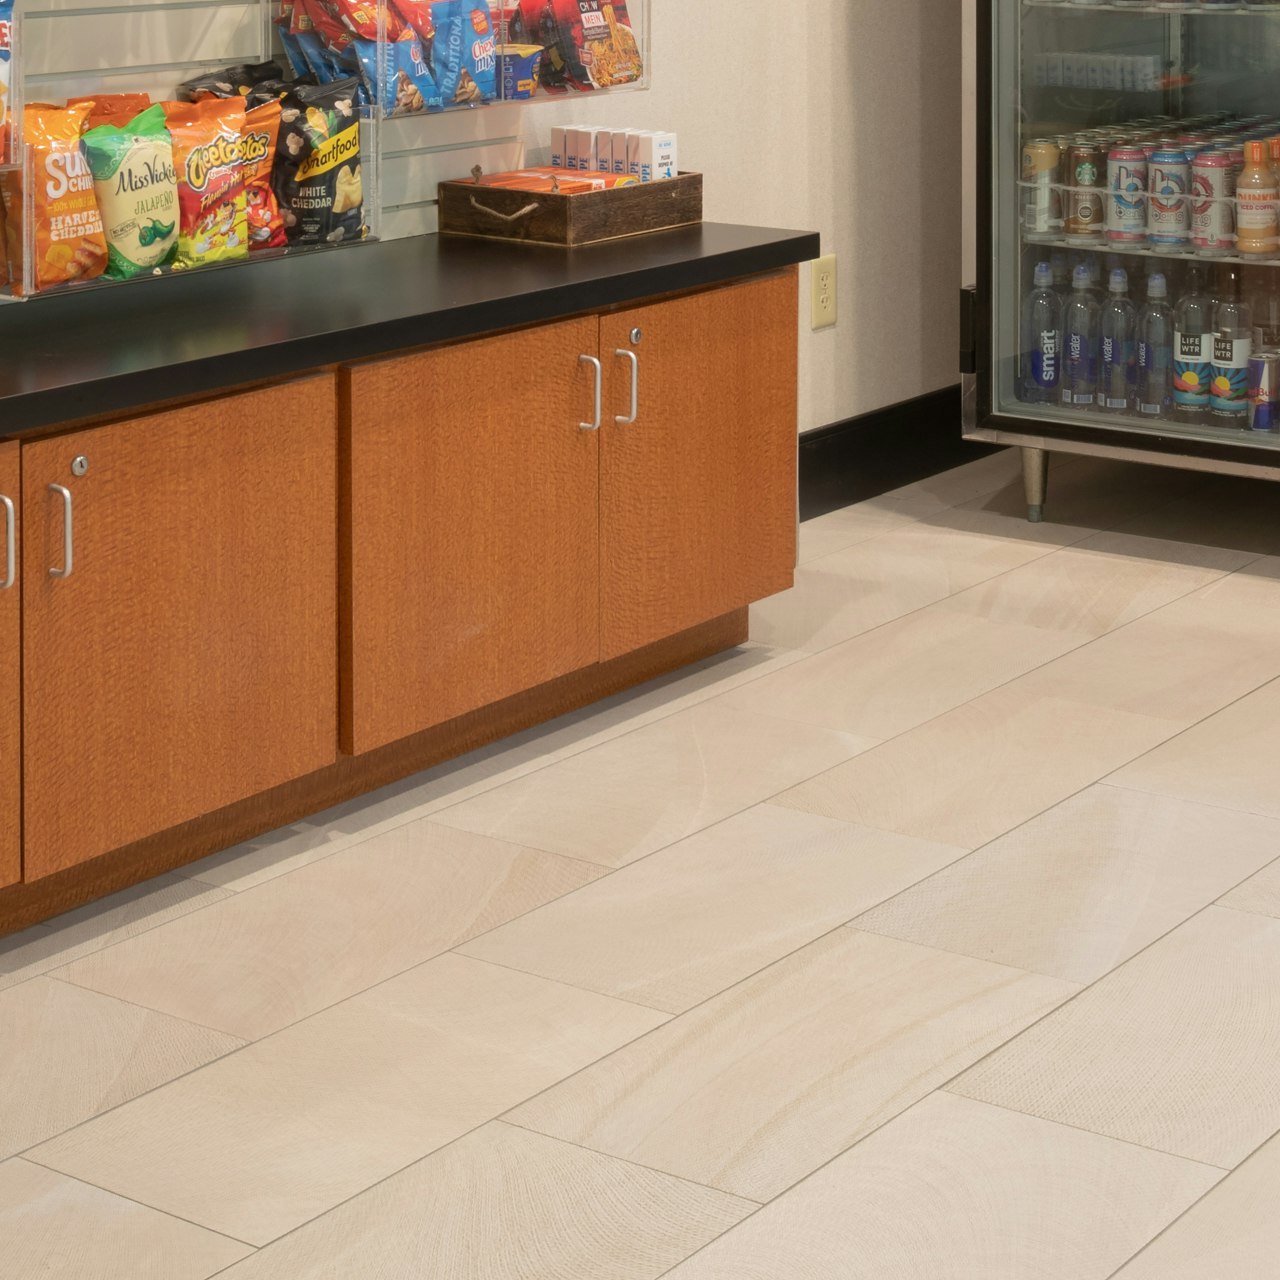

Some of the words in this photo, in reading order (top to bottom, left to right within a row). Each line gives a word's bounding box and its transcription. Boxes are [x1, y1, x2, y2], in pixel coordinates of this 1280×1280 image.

[584, 13, 602, 25] MEIN
[472, 38, 495, 58] Chex
[475, 53, 496, 73] mix
[300, 136, 358, 175] Smartfood
[299, 186, 326, 197] WHITE
[291, 197, 332, 209] CHEDDAR
[1070, 332, 1081, 359] water
[1103, 335, 1113, 362] water
[1181, 336, 1200, 346] LIFE
[1214, 341, 1232, 351] LIFE
[1041, 329, 1055, 382] smart
[1214, 349, 1232, 359] WTR
